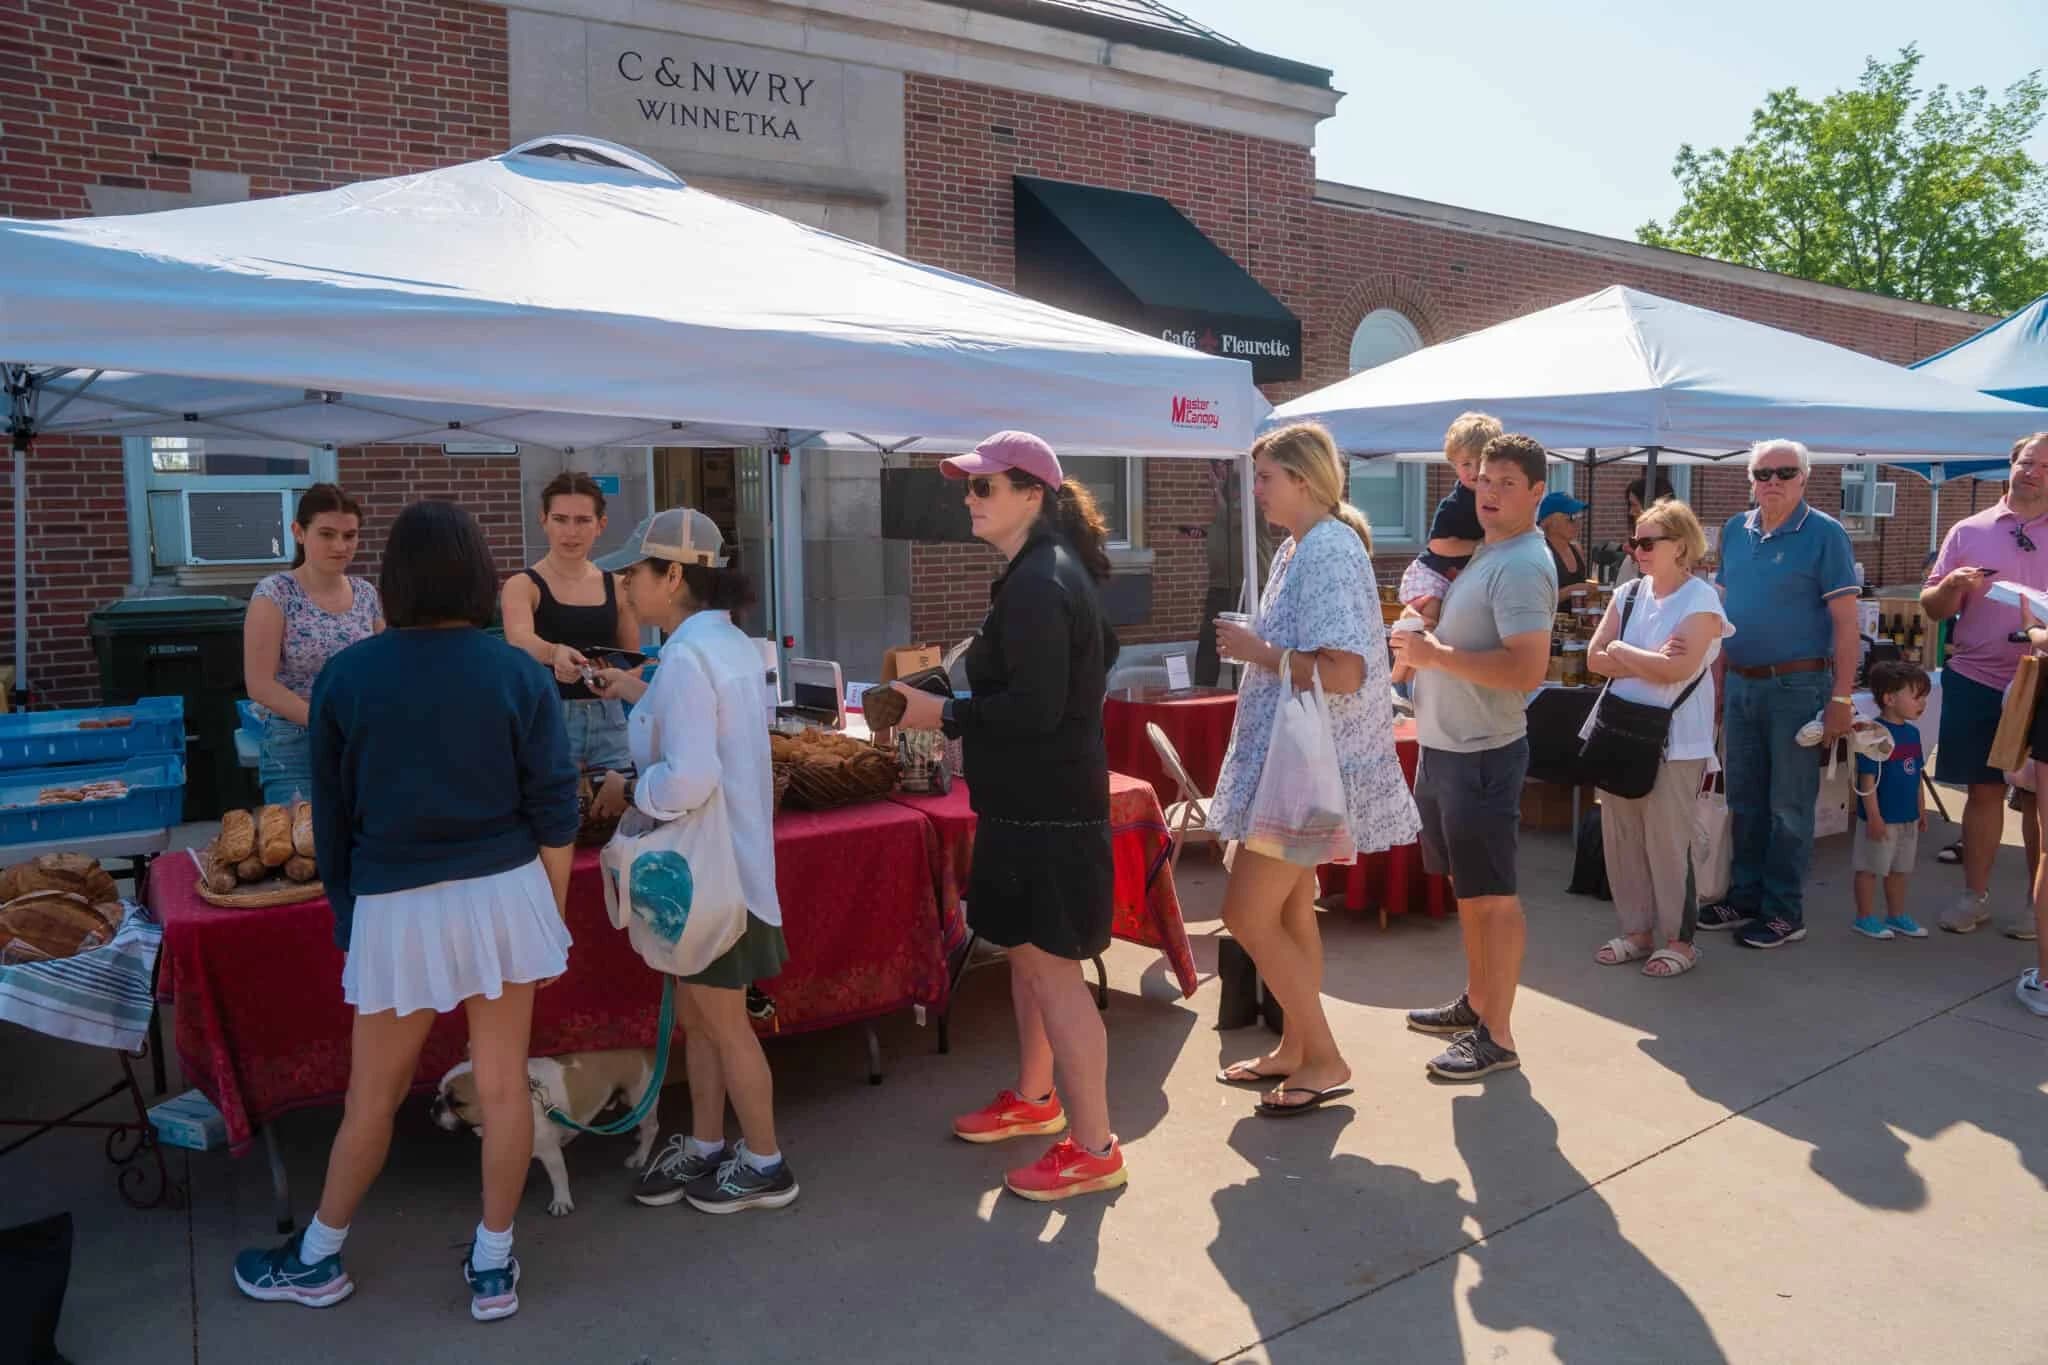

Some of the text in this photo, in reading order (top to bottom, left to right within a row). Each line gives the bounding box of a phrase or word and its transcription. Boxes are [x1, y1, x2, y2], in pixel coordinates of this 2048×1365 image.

[636, 98, 801, 140] WINNETKA
[1221, 334, 1290, 357] Fleurette
[1171, 396, 1210, 423] Master
[1186, 410, 1219, 429] Canopy
